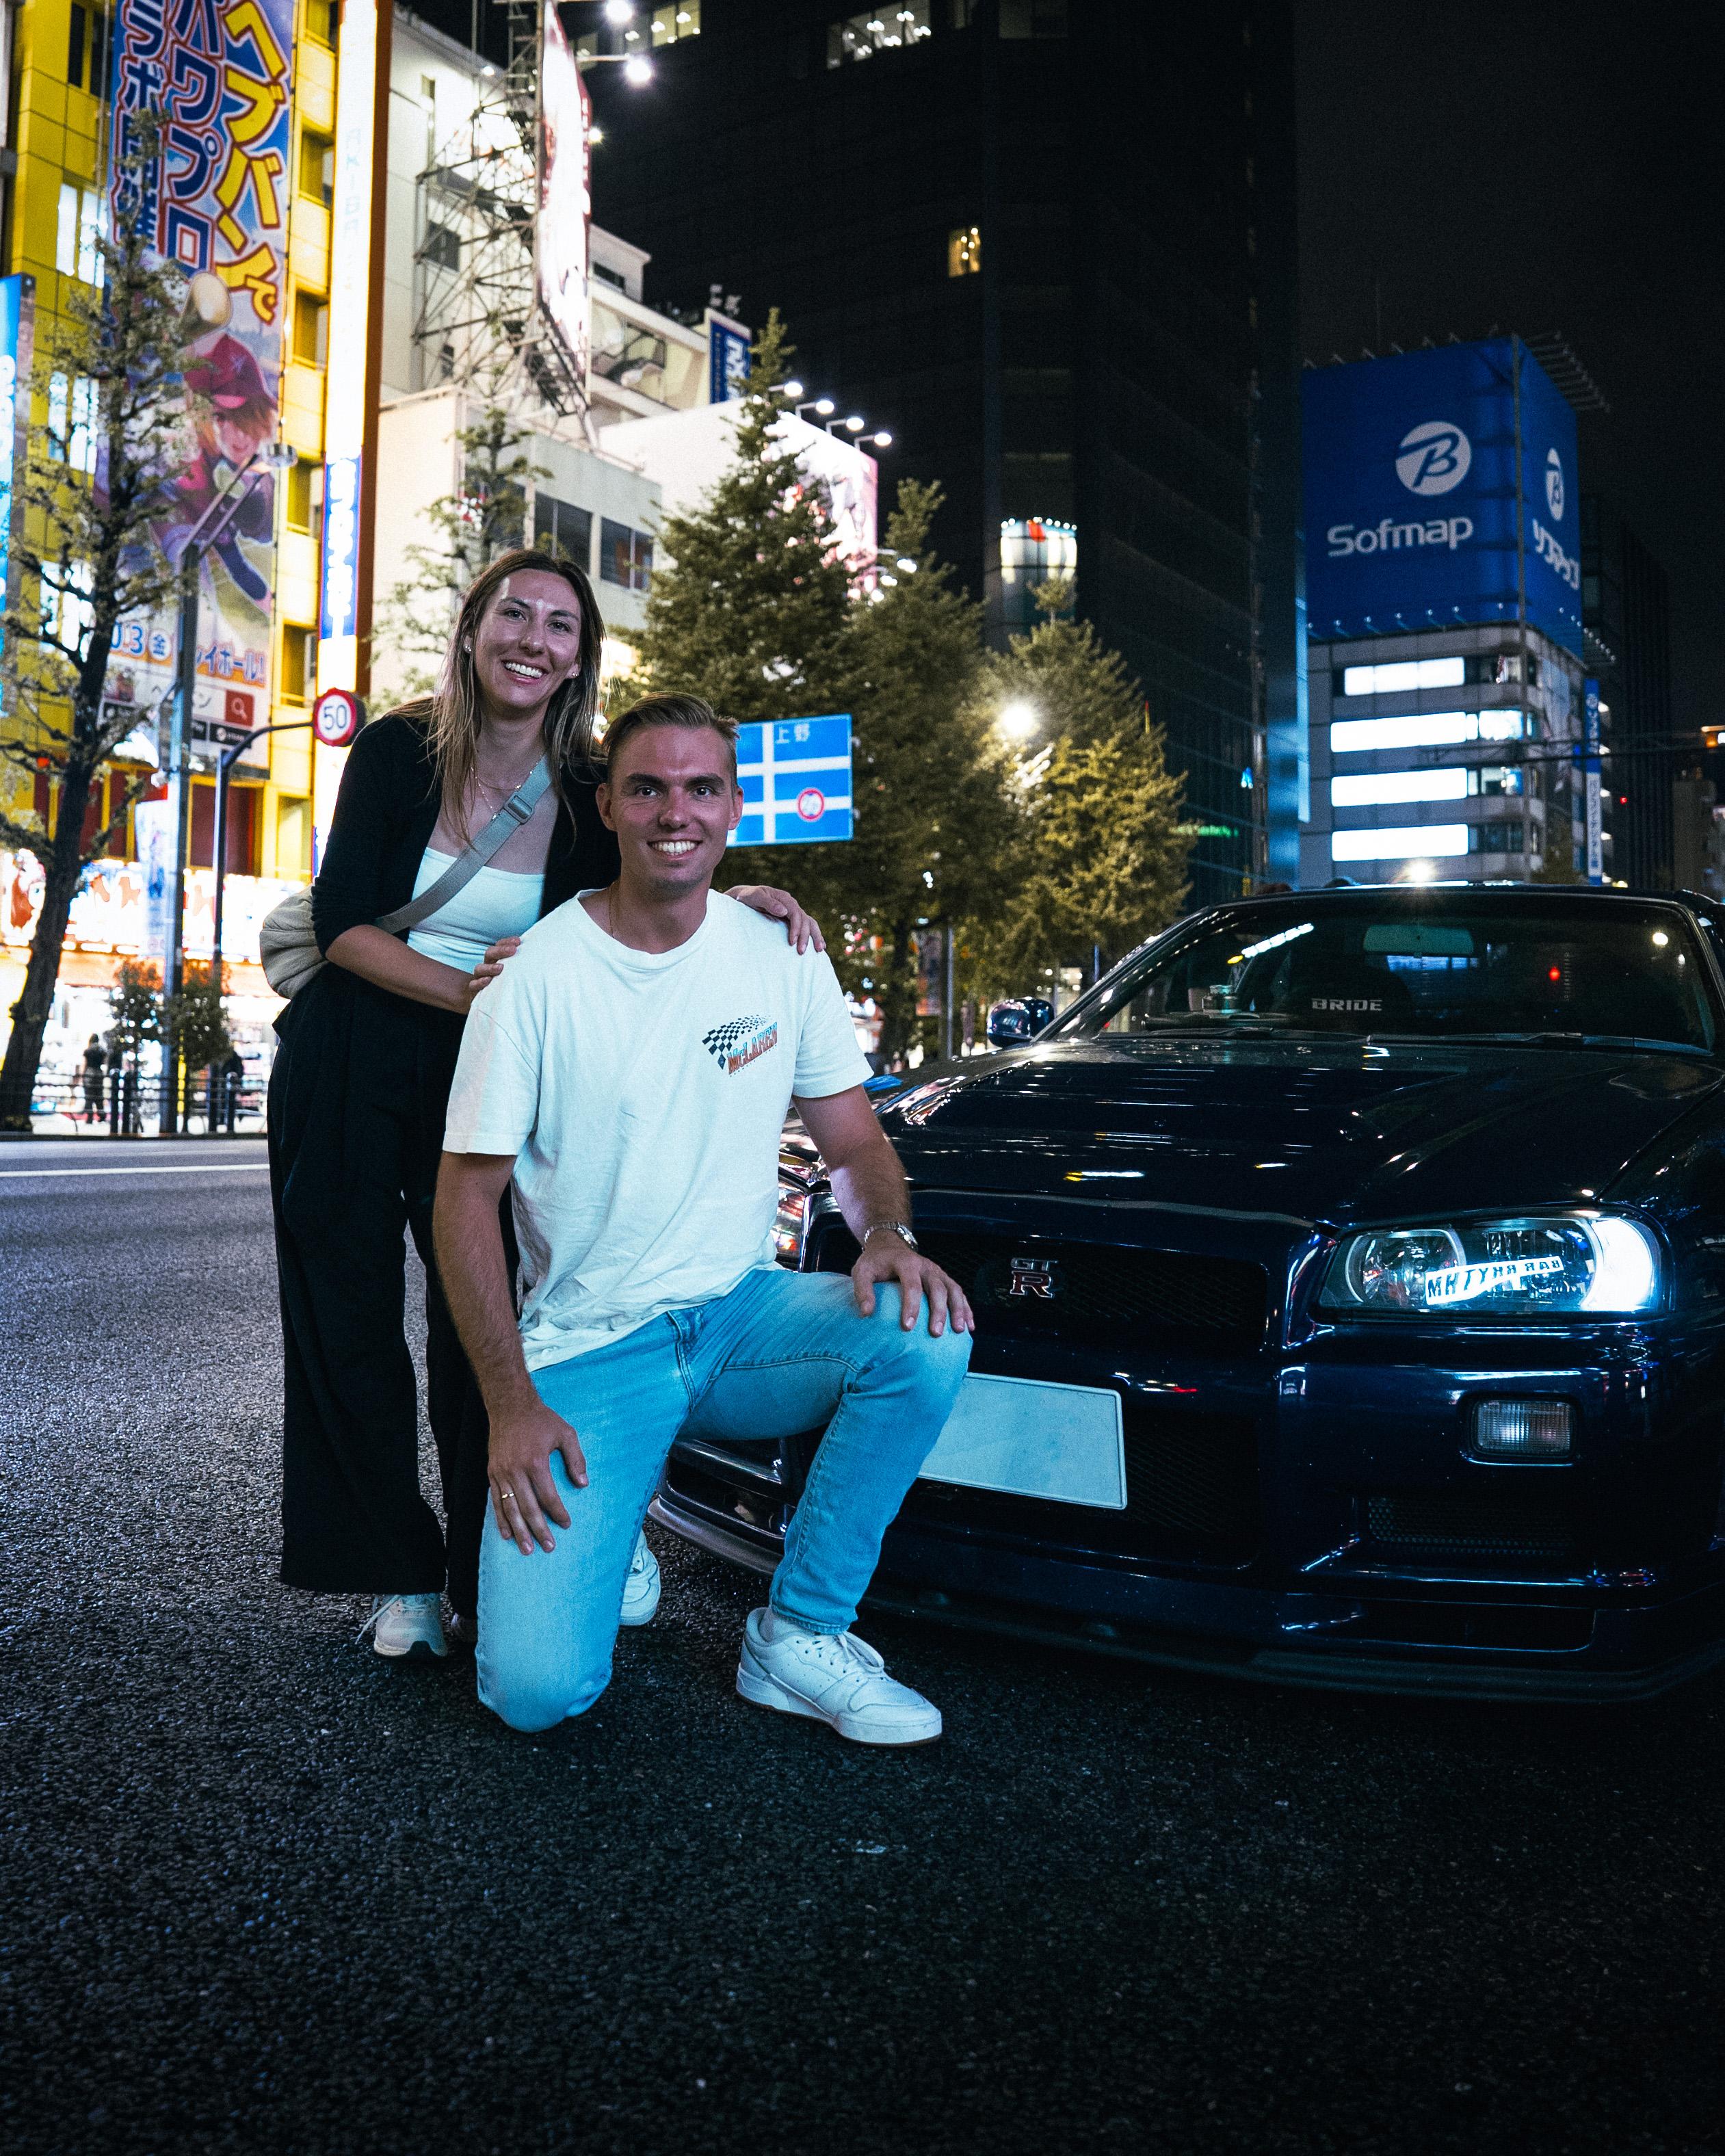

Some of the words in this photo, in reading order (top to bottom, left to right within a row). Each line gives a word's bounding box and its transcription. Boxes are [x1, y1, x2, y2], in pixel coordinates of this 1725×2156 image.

[1327, 516, 1473, 557] Sofmap
[324, 705, 347, 731] 50
[775, 722, 811, 744] 上野
[1312, 998, 1382, 1011] BRIDE
[1010, 1270, 1053, 1298] R
